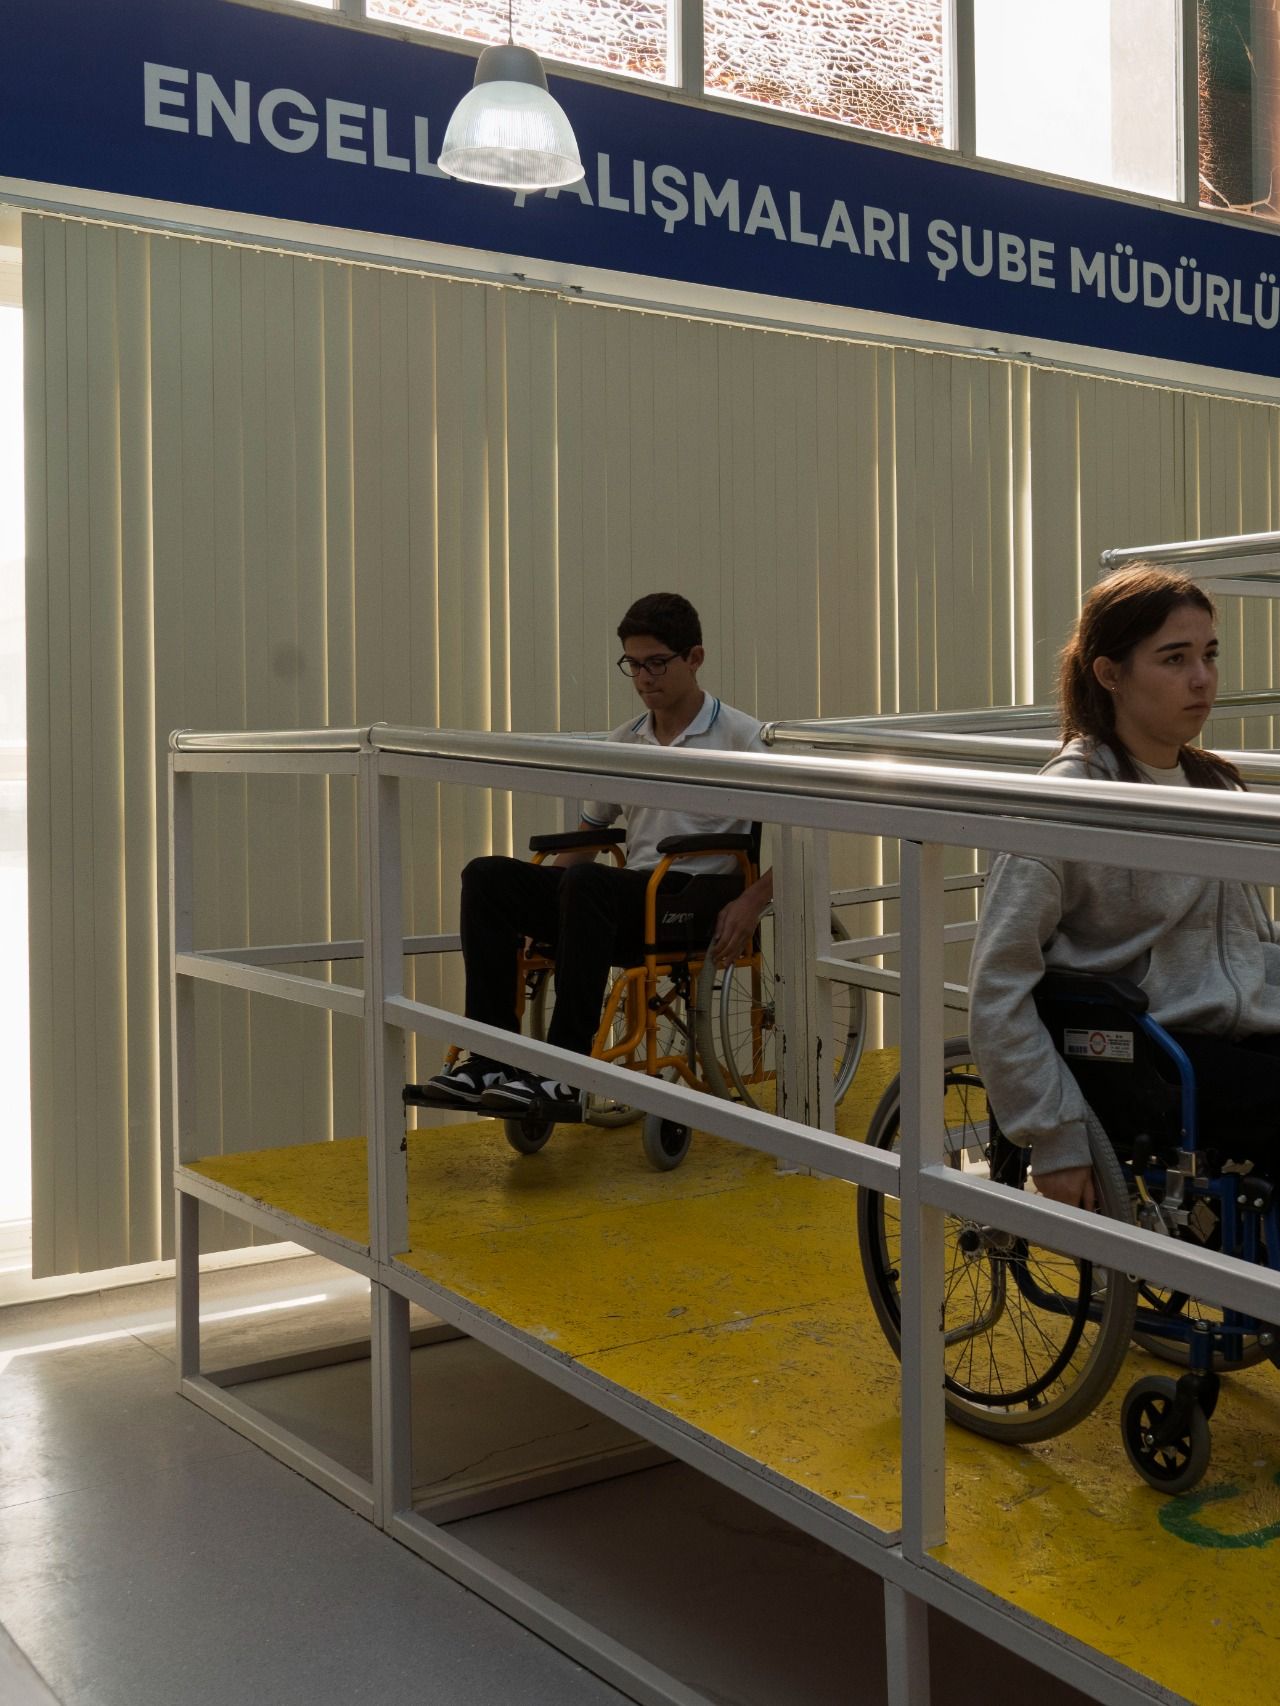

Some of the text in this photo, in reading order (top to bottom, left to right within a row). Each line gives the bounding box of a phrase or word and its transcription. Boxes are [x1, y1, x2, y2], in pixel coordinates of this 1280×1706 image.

[144, 62, 470, 183] ENGELL
[513, 153, 910, 262] LIŞMALARI
[928, 220, 1056, 288] ŞUBE
